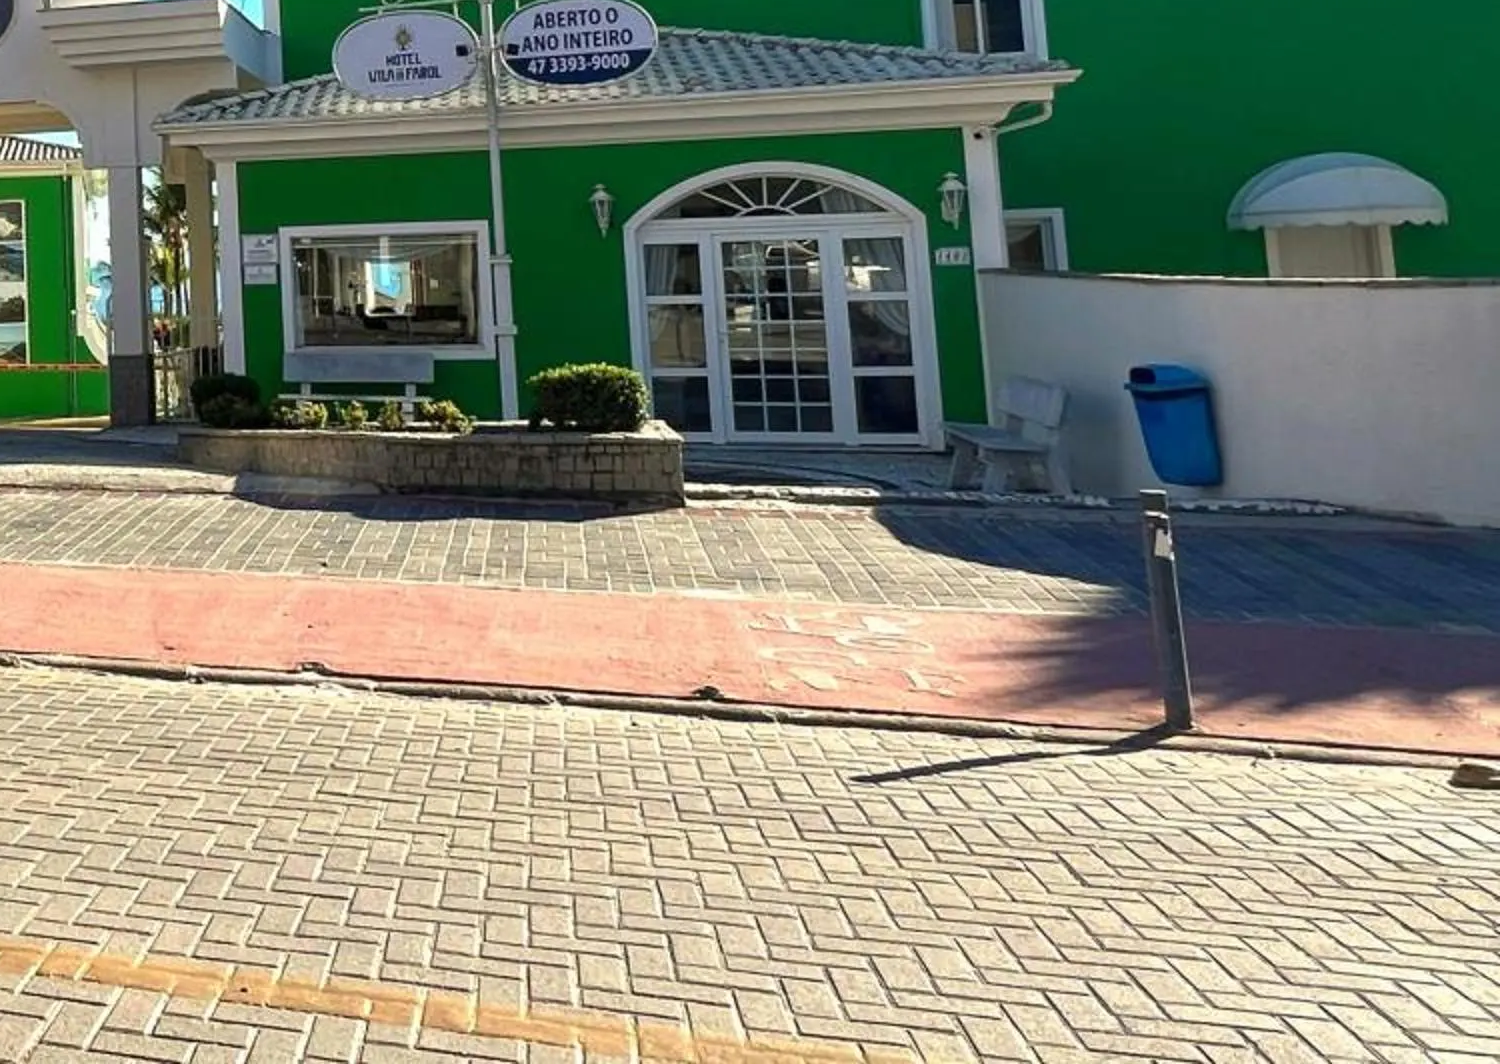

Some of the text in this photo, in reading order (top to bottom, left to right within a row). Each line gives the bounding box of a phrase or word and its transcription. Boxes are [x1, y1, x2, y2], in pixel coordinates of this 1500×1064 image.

[533, 7, 619, 30] ABERTO O
[521, 28, 633, 53] ANO INTEIRO
[385, 52, 422, 67] HOTEL
[527, 52, 630, 75] 47 3393-9000
[367, 70, 395, 83] VILA
